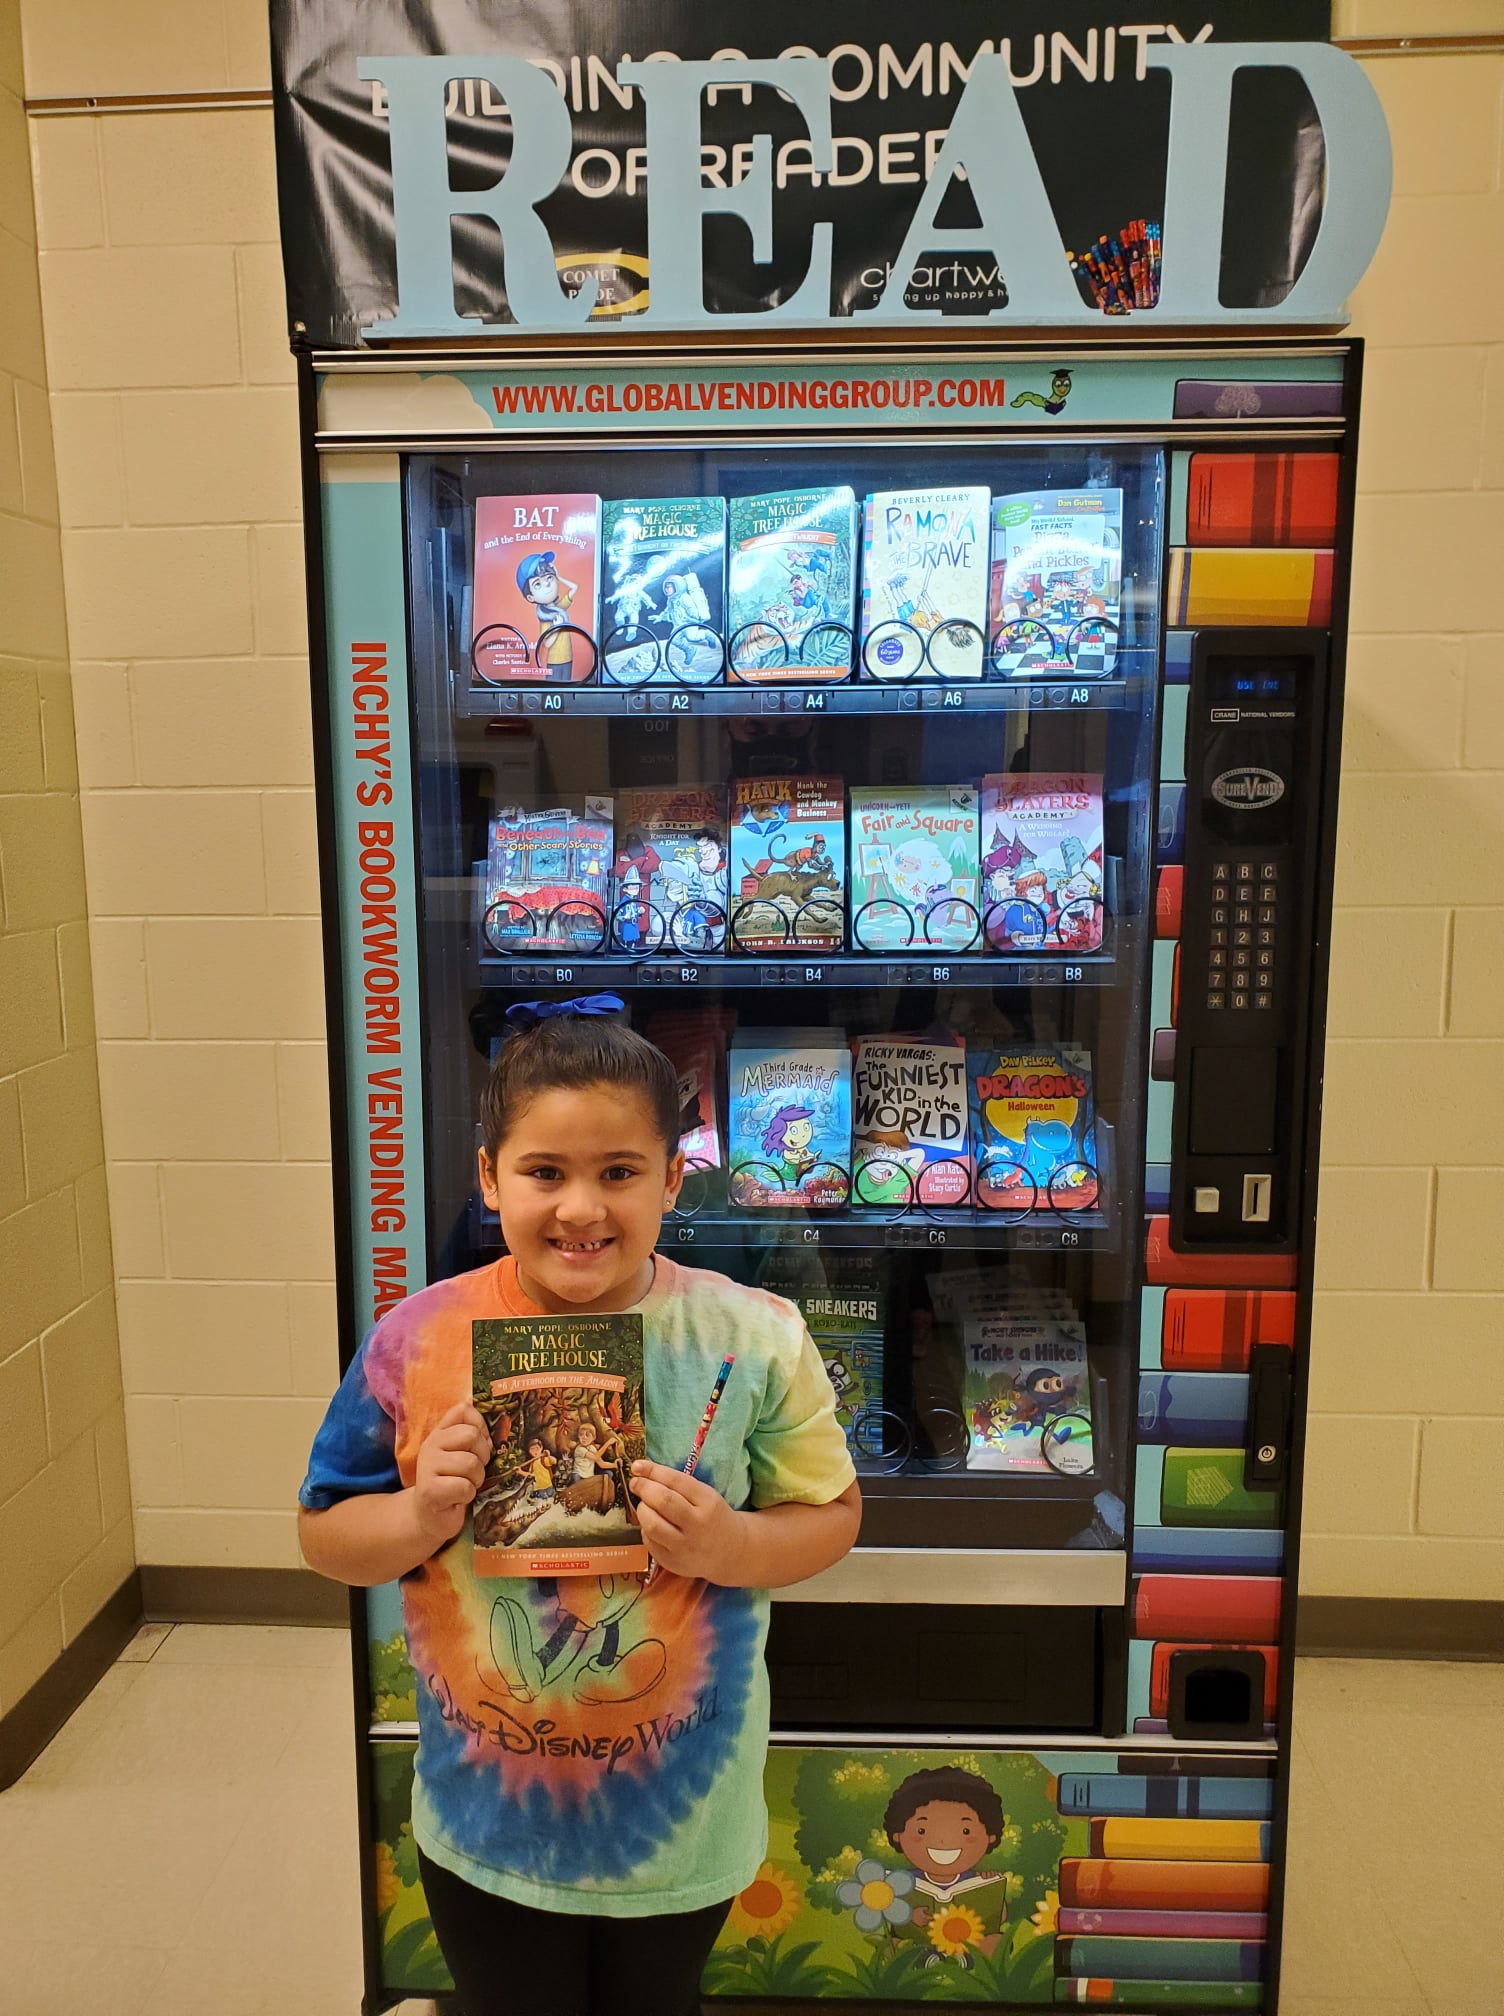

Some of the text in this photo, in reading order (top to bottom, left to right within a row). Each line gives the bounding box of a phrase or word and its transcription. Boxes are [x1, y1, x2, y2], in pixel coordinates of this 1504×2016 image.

[357, 41, 1393, 326] READ
[567, 287, 615, 301] PDE
[945, 290, 984, 300] happy
[493, 378, 1005, 413] WWW.GLOBALVENDINGGROUP.COM
[750, 493, 825, 508] MARY POPE OSBORNE
[892, 493, 971, 505] BEVERLY CLEARY
[1057, 499, 1072, 507] Dan
[623, 506, 645, 514] MARY
[768, 502, 807, 517] MAGIC
[512, 506, 560, 528] BAT
[642, 512, 682, 525] MAGIC
[658, 523, 698, 537] HOUSE
[752, 517, 781, 534] TREE
[886, 507, 975, 544] RAMONA
[1031, 523, 1049, 531] FAST
[484, 531, 587, 549] and the End of Everything
[907, 541, 973, 569] BRAVE
[1046, 554, 1090, 568] Pickles
[544, 695, 562, 709] A0
[671, 695, 689, 709] A2
[806, 693, 823, 709] A4
[944, 692, 962, 705] A6
[1070, 689, 1089, 702] A8
[351, 642, 393, 807] INCHY'S
[736, 780, 793, 805] HANK
[797, 781, 814, 790] Hank
[797, 790, 822, 800] Cowdog
[797, 799, 838, 809] and Monkey
[860, 801, 912, 812] UNICORN YETI
[994, 793, 1090, 812] SLAYERS
[797, 808, 827, 817] Business
[1012, 811, 1065, 819] ACADEMY
[861, 809, 974, 837] Fair and Square
[495, 824, 606, 841] Beneath Bed
[509, 840, 603, 851] Other Scary Stories
[1216, 866, 1273, 879] A B C
[1216, 888, 1271, 900] D E F
[1215, 910, 1270, 922] G H J
[358, 821, 401, 1054] BOOKWORM
[1216, 931, 1270, 943] 1 2 3
[1213, 953, 1269, 964] 4 5 6
[556, 968, 573, 982] B0
[681, 968, 698, 982] B2
[806, 968, 822, 981] B4
[933, 967, 950, 980] B6
[1065, 967, 1083, 980] B8
[1213, 974, 1268, 986] 7 8 9
[864, 1047, 936, 1061] RICKY VARGAS:
[763, 1061, 813, 1073] Third Grade
[865, 1061, 886, 1071] The
[1000, 1056, 1021, 1068] DAV
[856, 1061, 964, 1097] FUNNIEST
[881, 1086, 962, 1112] KID in the
[1007, 1102, 1055, 1111] Halloween
[855, 1094, 961, 1140] WORLD
[367, 1067, 407, 1233] VENDING
[678, 1228, 695, 1241] C2
[803, 1229, 820, 1241] C4
[929, 1230, 946, 1244] C6
[1062, 1232, 1079, 1245] C8
[806, 1298, 877, 1321] SNEAKERS
[504, 1323, 612, 1335] MARY POPE OSBORNE
[531, 1334, 585, 1351] MAGIC
[508, 1349, 608, 1371] TREE HOUSE
[970, 1343, 1083, 1363] Take a Hike!
[510, 1376, 619, 1390] AFTERNOON ON THE AMAZON
[634, 1686, 721, 1753] World
